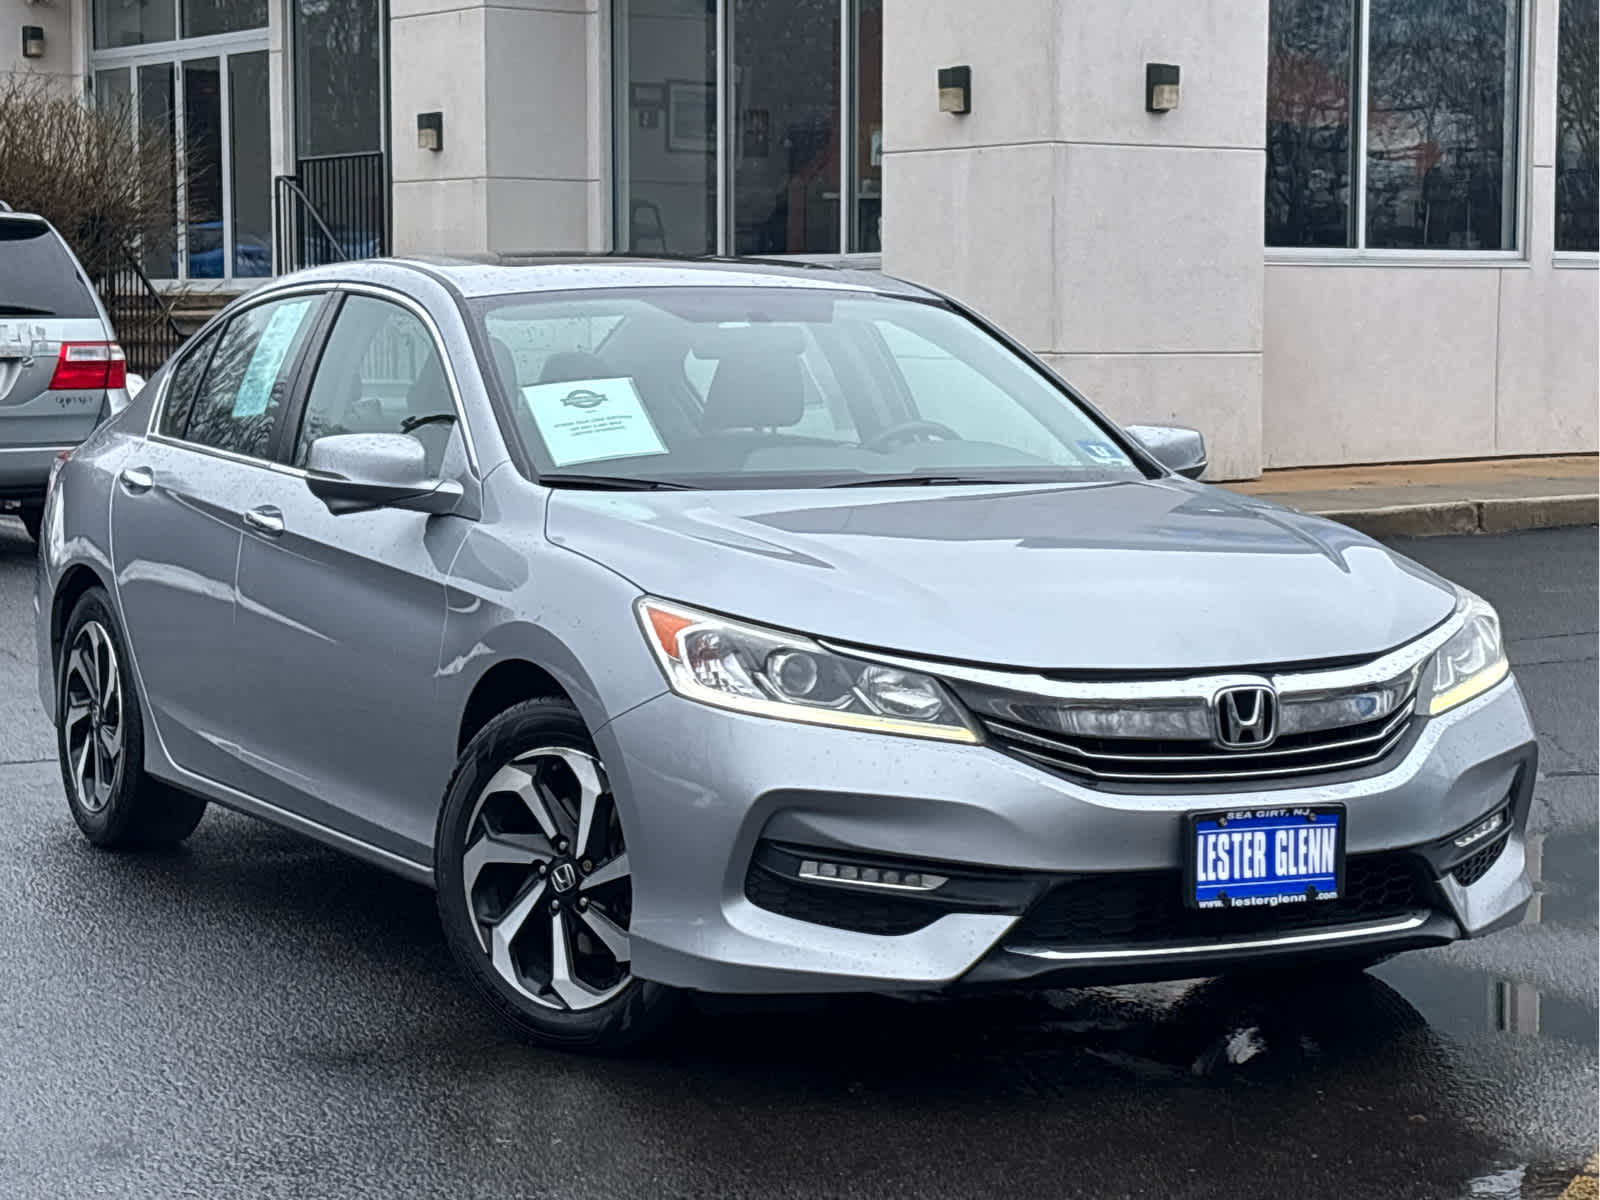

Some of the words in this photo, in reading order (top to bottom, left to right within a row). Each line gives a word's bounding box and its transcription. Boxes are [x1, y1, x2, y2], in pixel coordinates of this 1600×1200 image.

[1226, 811, 1252, 820] SEA
[1293, 808, 1310, 816] NJ
[1197, 831, 1266, 882] LESTER
[1275, 828, 1336, 876] GLENN
[1231, 894, 1307, 907] lesterglenn
[1315, 892, 1338, 900] .com
